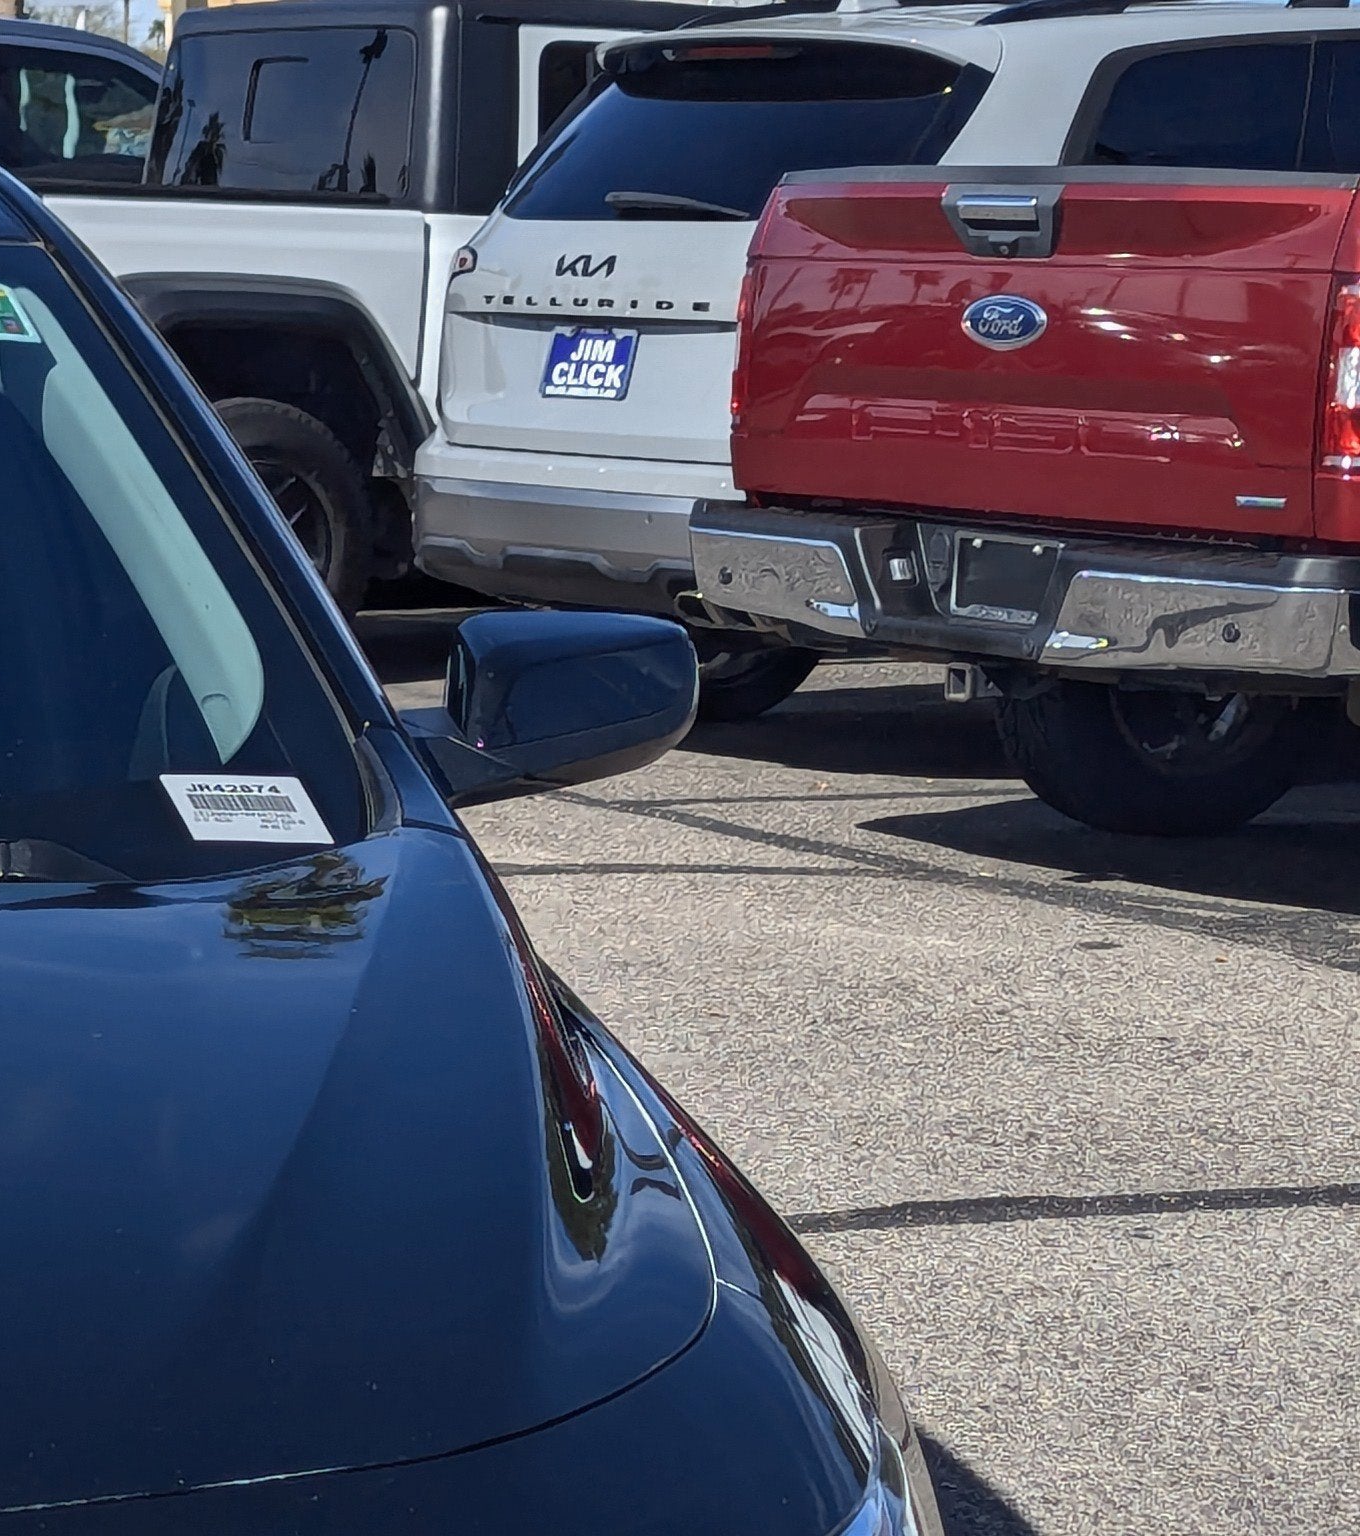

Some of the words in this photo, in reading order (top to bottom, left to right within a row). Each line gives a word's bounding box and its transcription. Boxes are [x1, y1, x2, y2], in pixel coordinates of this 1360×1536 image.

[483, 294, 711, 313] TELLURIDE
[977, 305, 1025, 336] Ford
[569, 339, 616, 363] JIM
[550, 361, 626, 388] CLICK
